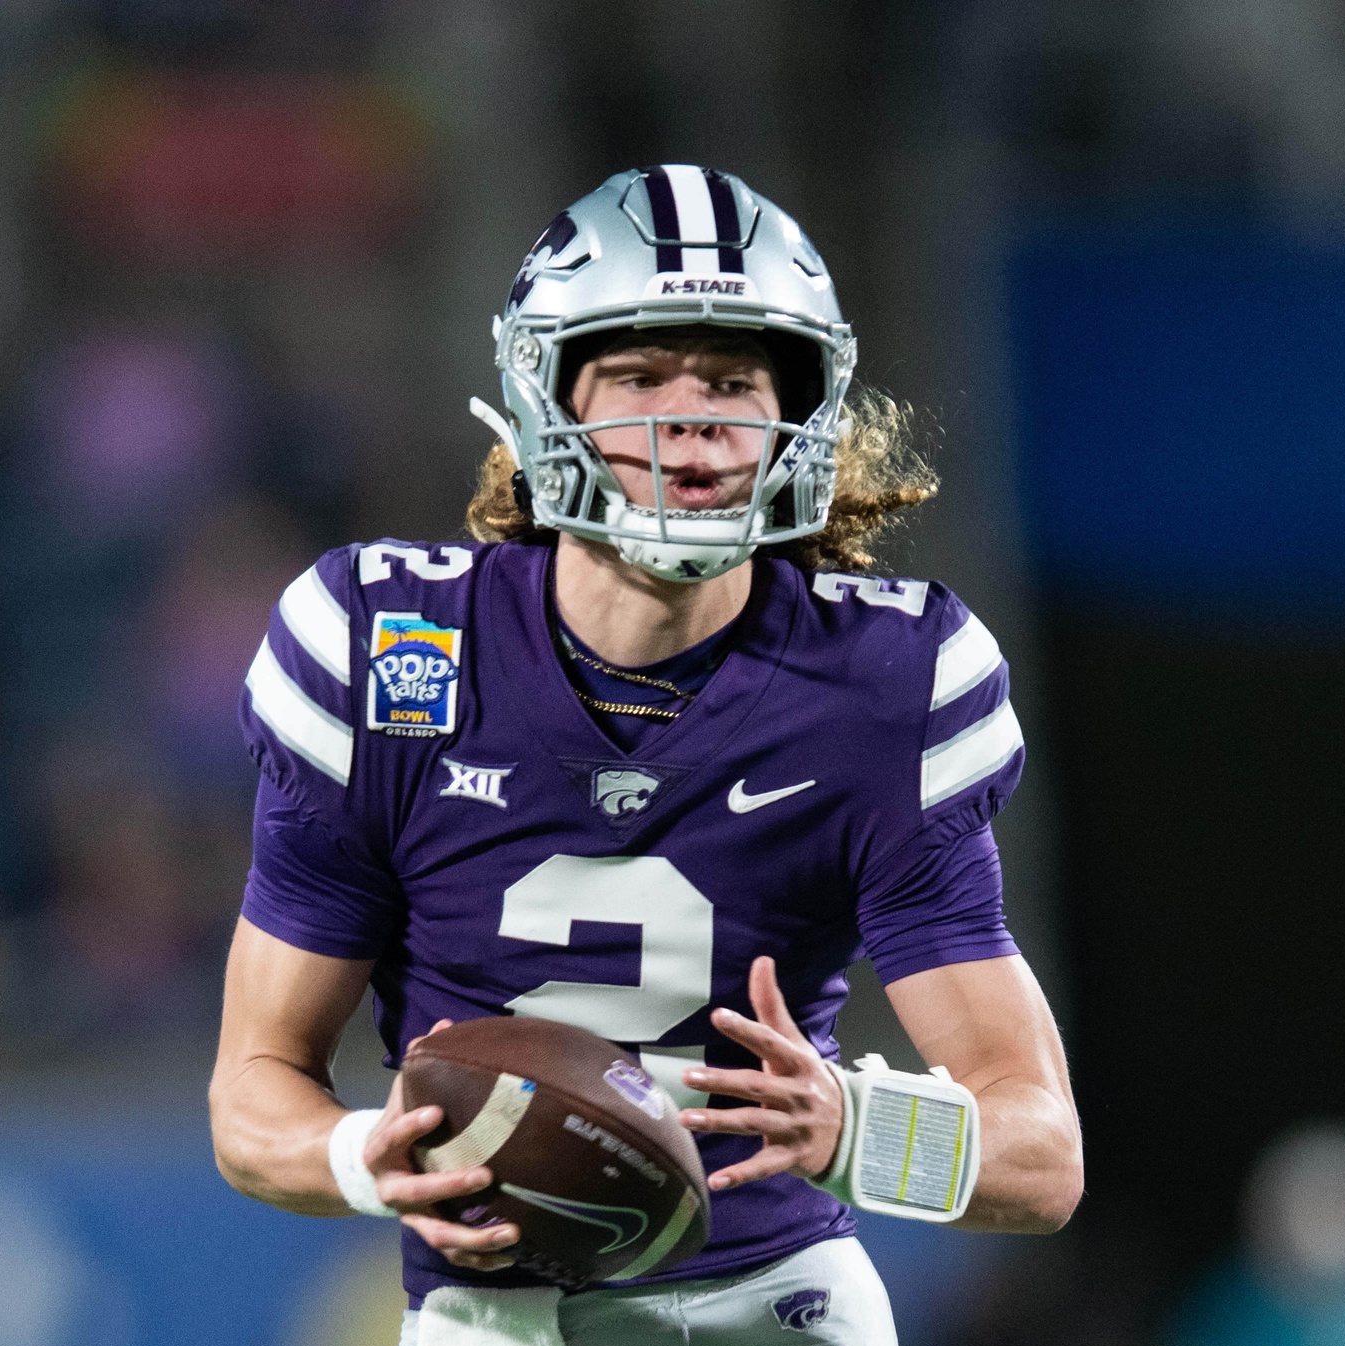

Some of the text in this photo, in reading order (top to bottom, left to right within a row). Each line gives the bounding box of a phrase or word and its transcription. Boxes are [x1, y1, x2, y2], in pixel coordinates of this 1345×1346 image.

[661, 279, 746, 296] K-STATE
[359, 543, 473, 586] 2
[812, 572, 929, 617] 2
[386, 727, 437, 738] ORLANDO
[390, 710, 433, 723] BOWL
[439, 757, 513, 808] XII
[498, 853, 714, 1110] 2
